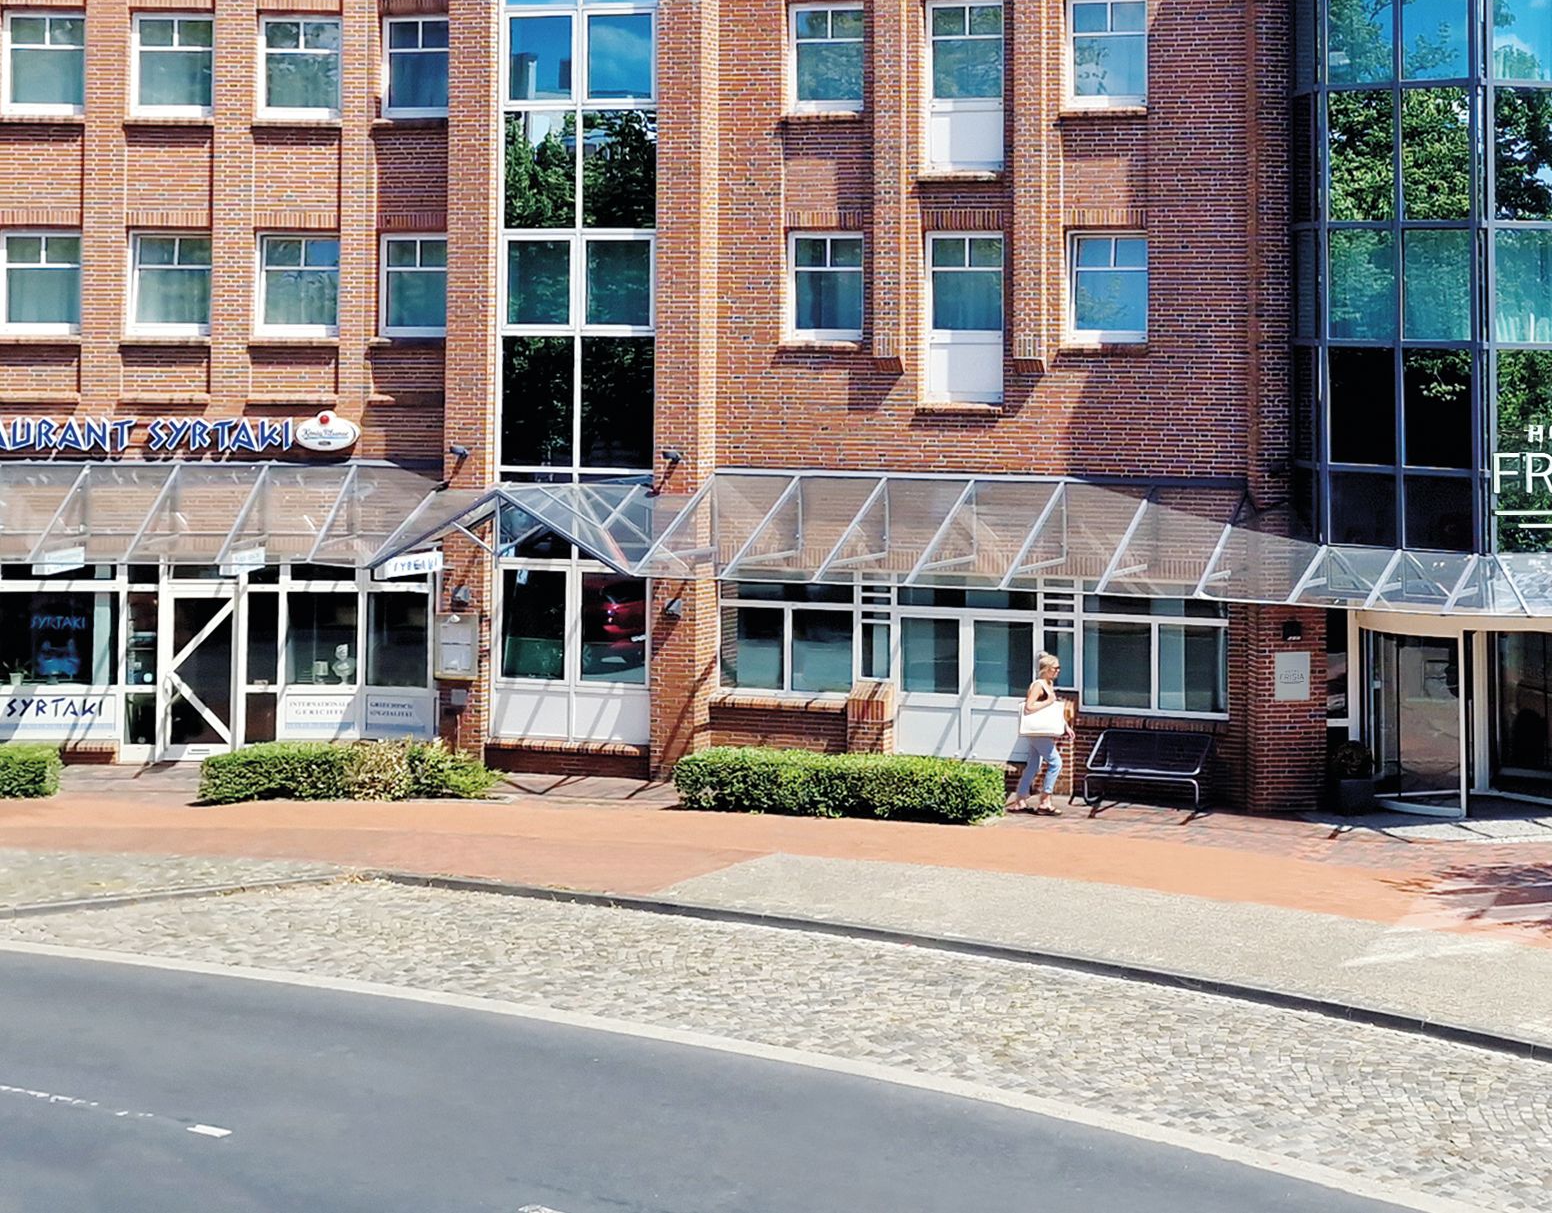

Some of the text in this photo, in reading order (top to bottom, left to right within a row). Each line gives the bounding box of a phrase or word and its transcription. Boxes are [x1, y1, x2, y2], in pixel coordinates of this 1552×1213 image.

[148, 418, 294, 451] SYRTAKI
[31, 615, 86, 629] SYRTAKI
[7, 697, 104, 717] SYRTAKI
